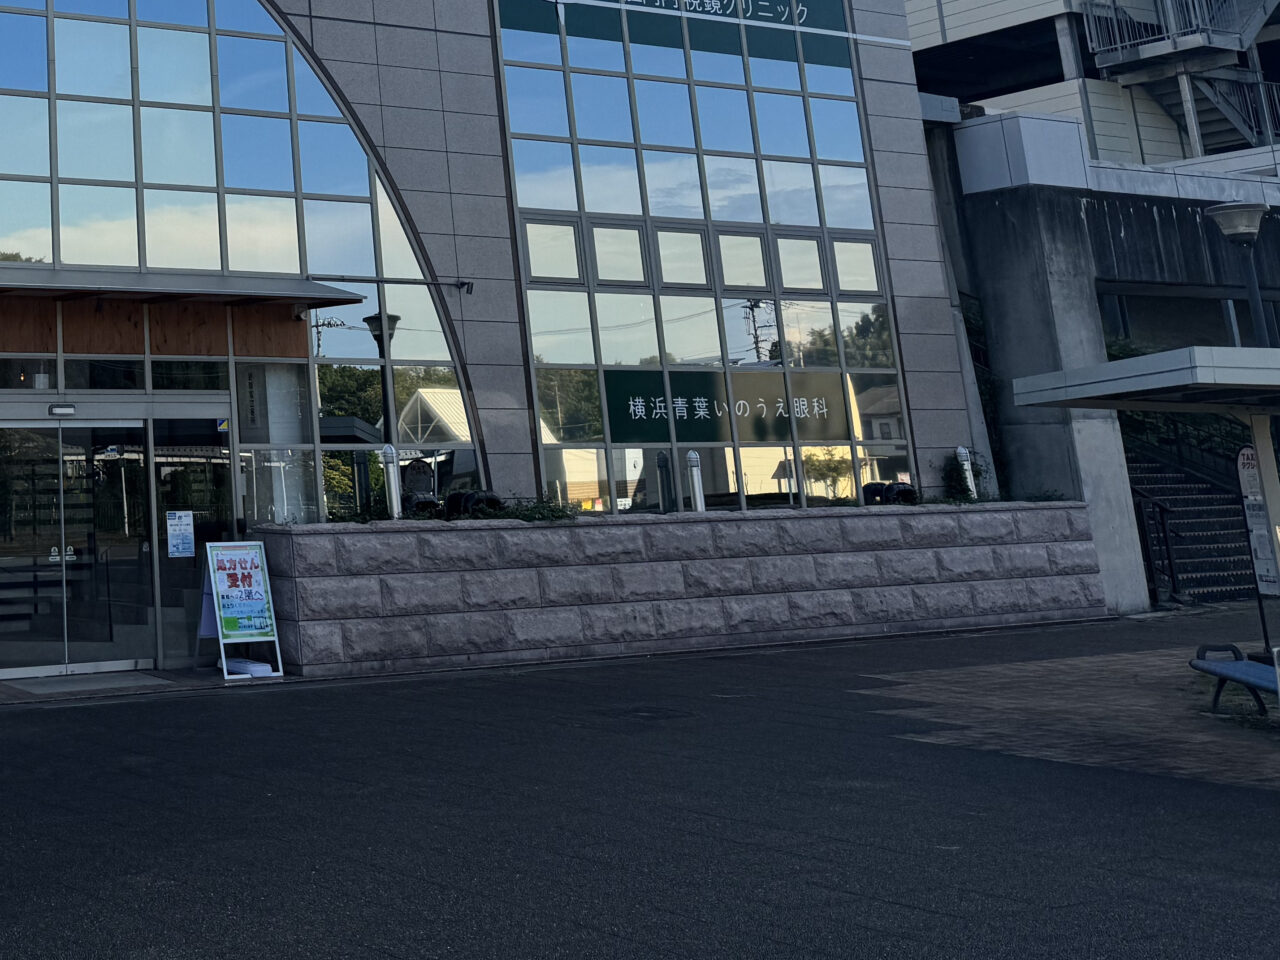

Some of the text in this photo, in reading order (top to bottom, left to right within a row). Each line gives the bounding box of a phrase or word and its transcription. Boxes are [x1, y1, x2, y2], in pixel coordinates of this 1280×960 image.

[628, 396, 829, 420] 横浜青葉いのうえ眼科
[216, 557, 260, 572] 処方せん
[226, 571, 253, 589] 受付
